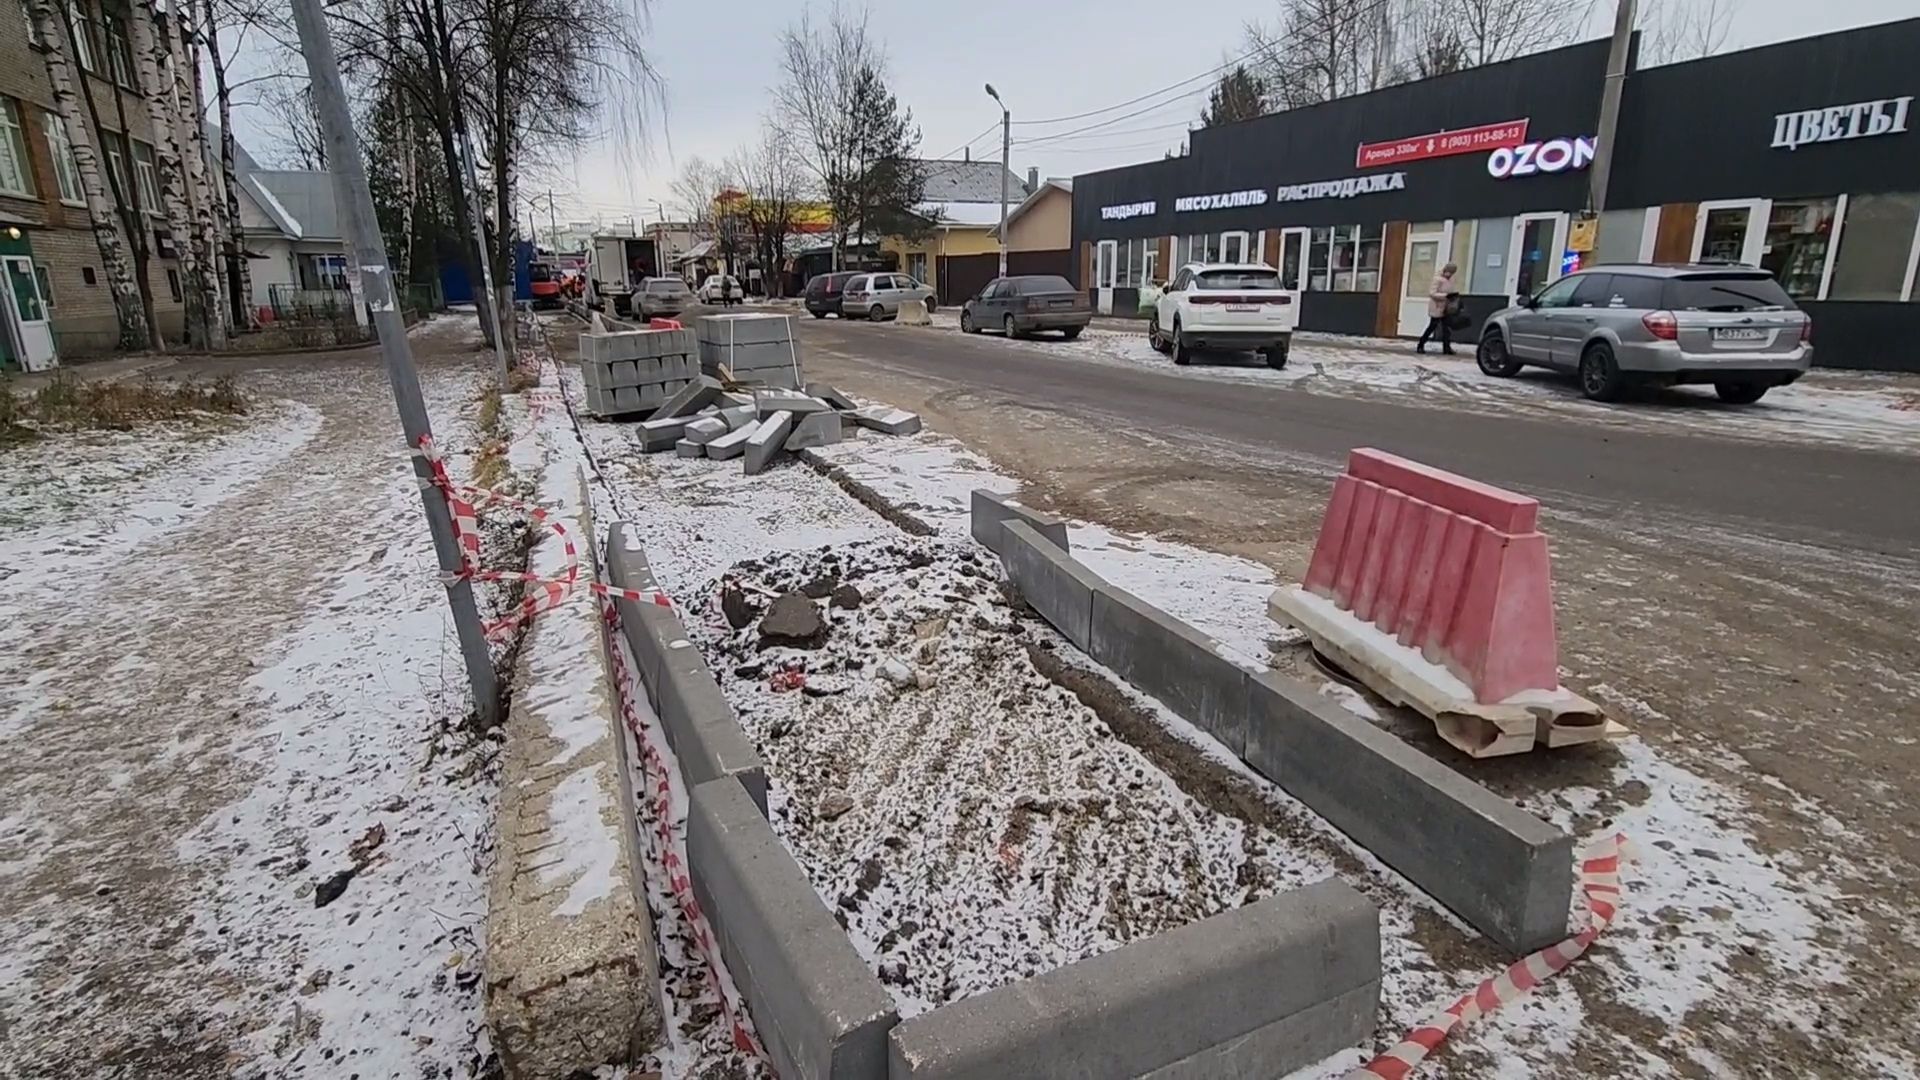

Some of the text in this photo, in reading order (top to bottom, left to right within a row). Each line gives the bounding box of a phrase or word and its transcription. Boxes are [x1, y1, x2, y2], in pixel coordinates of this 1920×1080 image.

[1770, 96, 1914, 151] ЦВЕТЫ
[1365, 147, 1395, 160] Аренда
[1487, 135, 1599, 178] OZON
[1174, 189, 1268, 212] МЯСО ХАЛЯЛЬ
[1276, 171, 1407, 203] РАСПРОДАЖА
